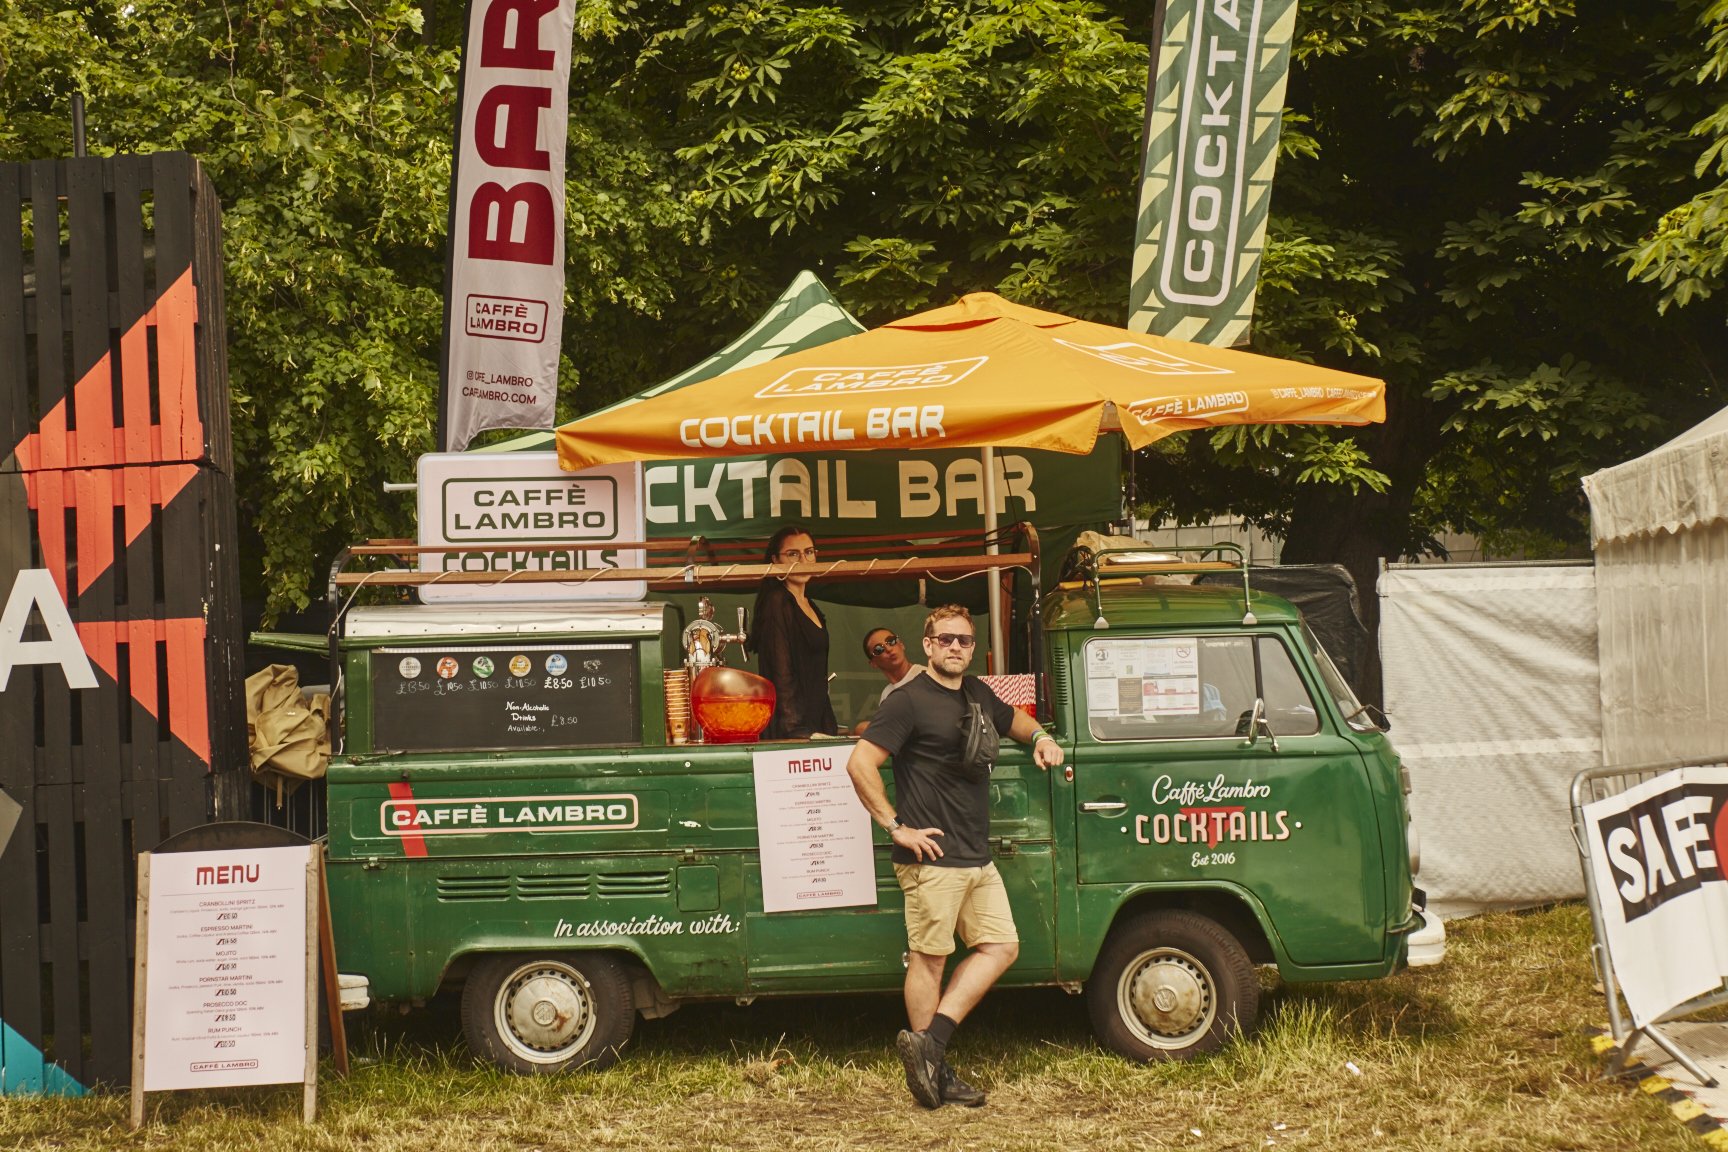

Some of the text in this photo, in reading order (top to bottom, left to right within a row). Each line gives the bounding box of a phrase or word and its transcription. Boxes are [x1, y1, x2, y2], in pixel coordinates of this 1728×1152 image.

[468, 0, 560, 266] BAR
[475, 302, 529, 319] CAFFÈ
[469, 316, 538, 335] LAMBRO
[774, 373, 954, 392] LAMBRO
[812, 364, 948, 382] CAFFÈ
[1187, 391, 1245, 413] LAMBRO
[679, 404, 946, 448] COCKTAIL BAR
[473, 483, 587, 507] CAFFÈ
[898, 455, 1037, 519] BAR
[454, 511, 606, 530] LAMBRO
[510, 712, 537, 721] Drinks
[788, 757, 833, 774] MENU
[1203, 773, 1271, 802] Lambro
[391, 803, 628, 827] CAFFÈ LAMBRO
[1135, 810, 1291, 845] COCKTAILS
[1191, 851, 1236, 868] Est 2016
[1607, 796, 1718, 904] SAFE
[195, 863, 261, 886] MENU
[553, 913, 741, 938] In association with:
[221, 1061, 256, 1069] LAMBRO
